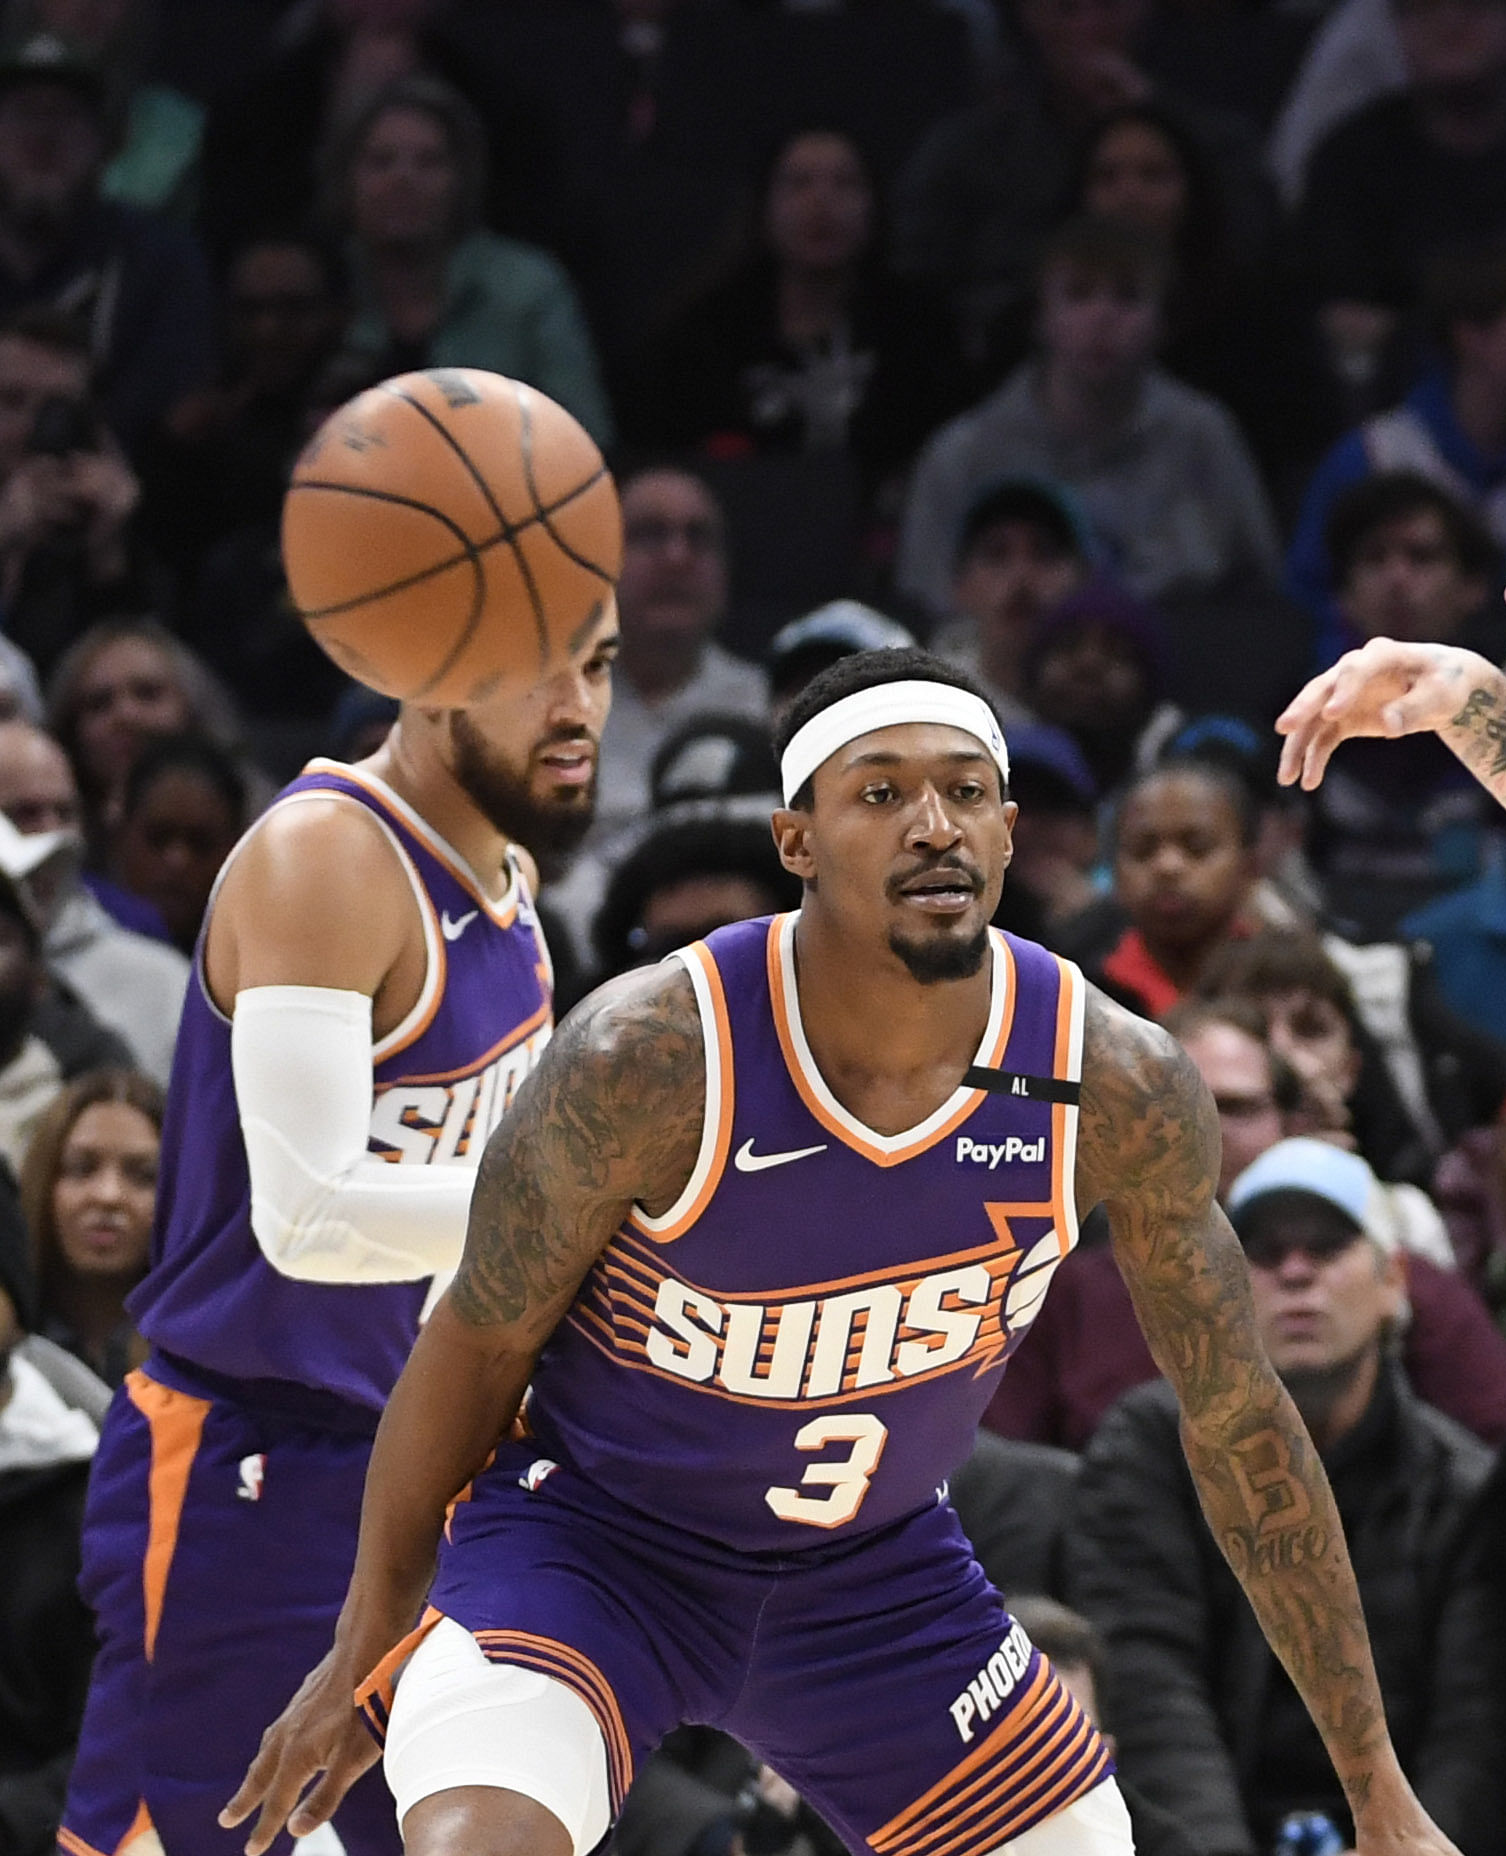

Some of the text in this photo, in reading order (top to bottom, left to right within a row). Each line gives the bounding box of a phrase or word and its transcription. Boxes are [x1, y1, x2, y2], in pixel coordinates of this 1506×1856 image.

[1011, 1076, 1029, 1096] AL
[956, 1136, 1046, 1170] PayPal
[764, 1413, 889, 1530] 3
